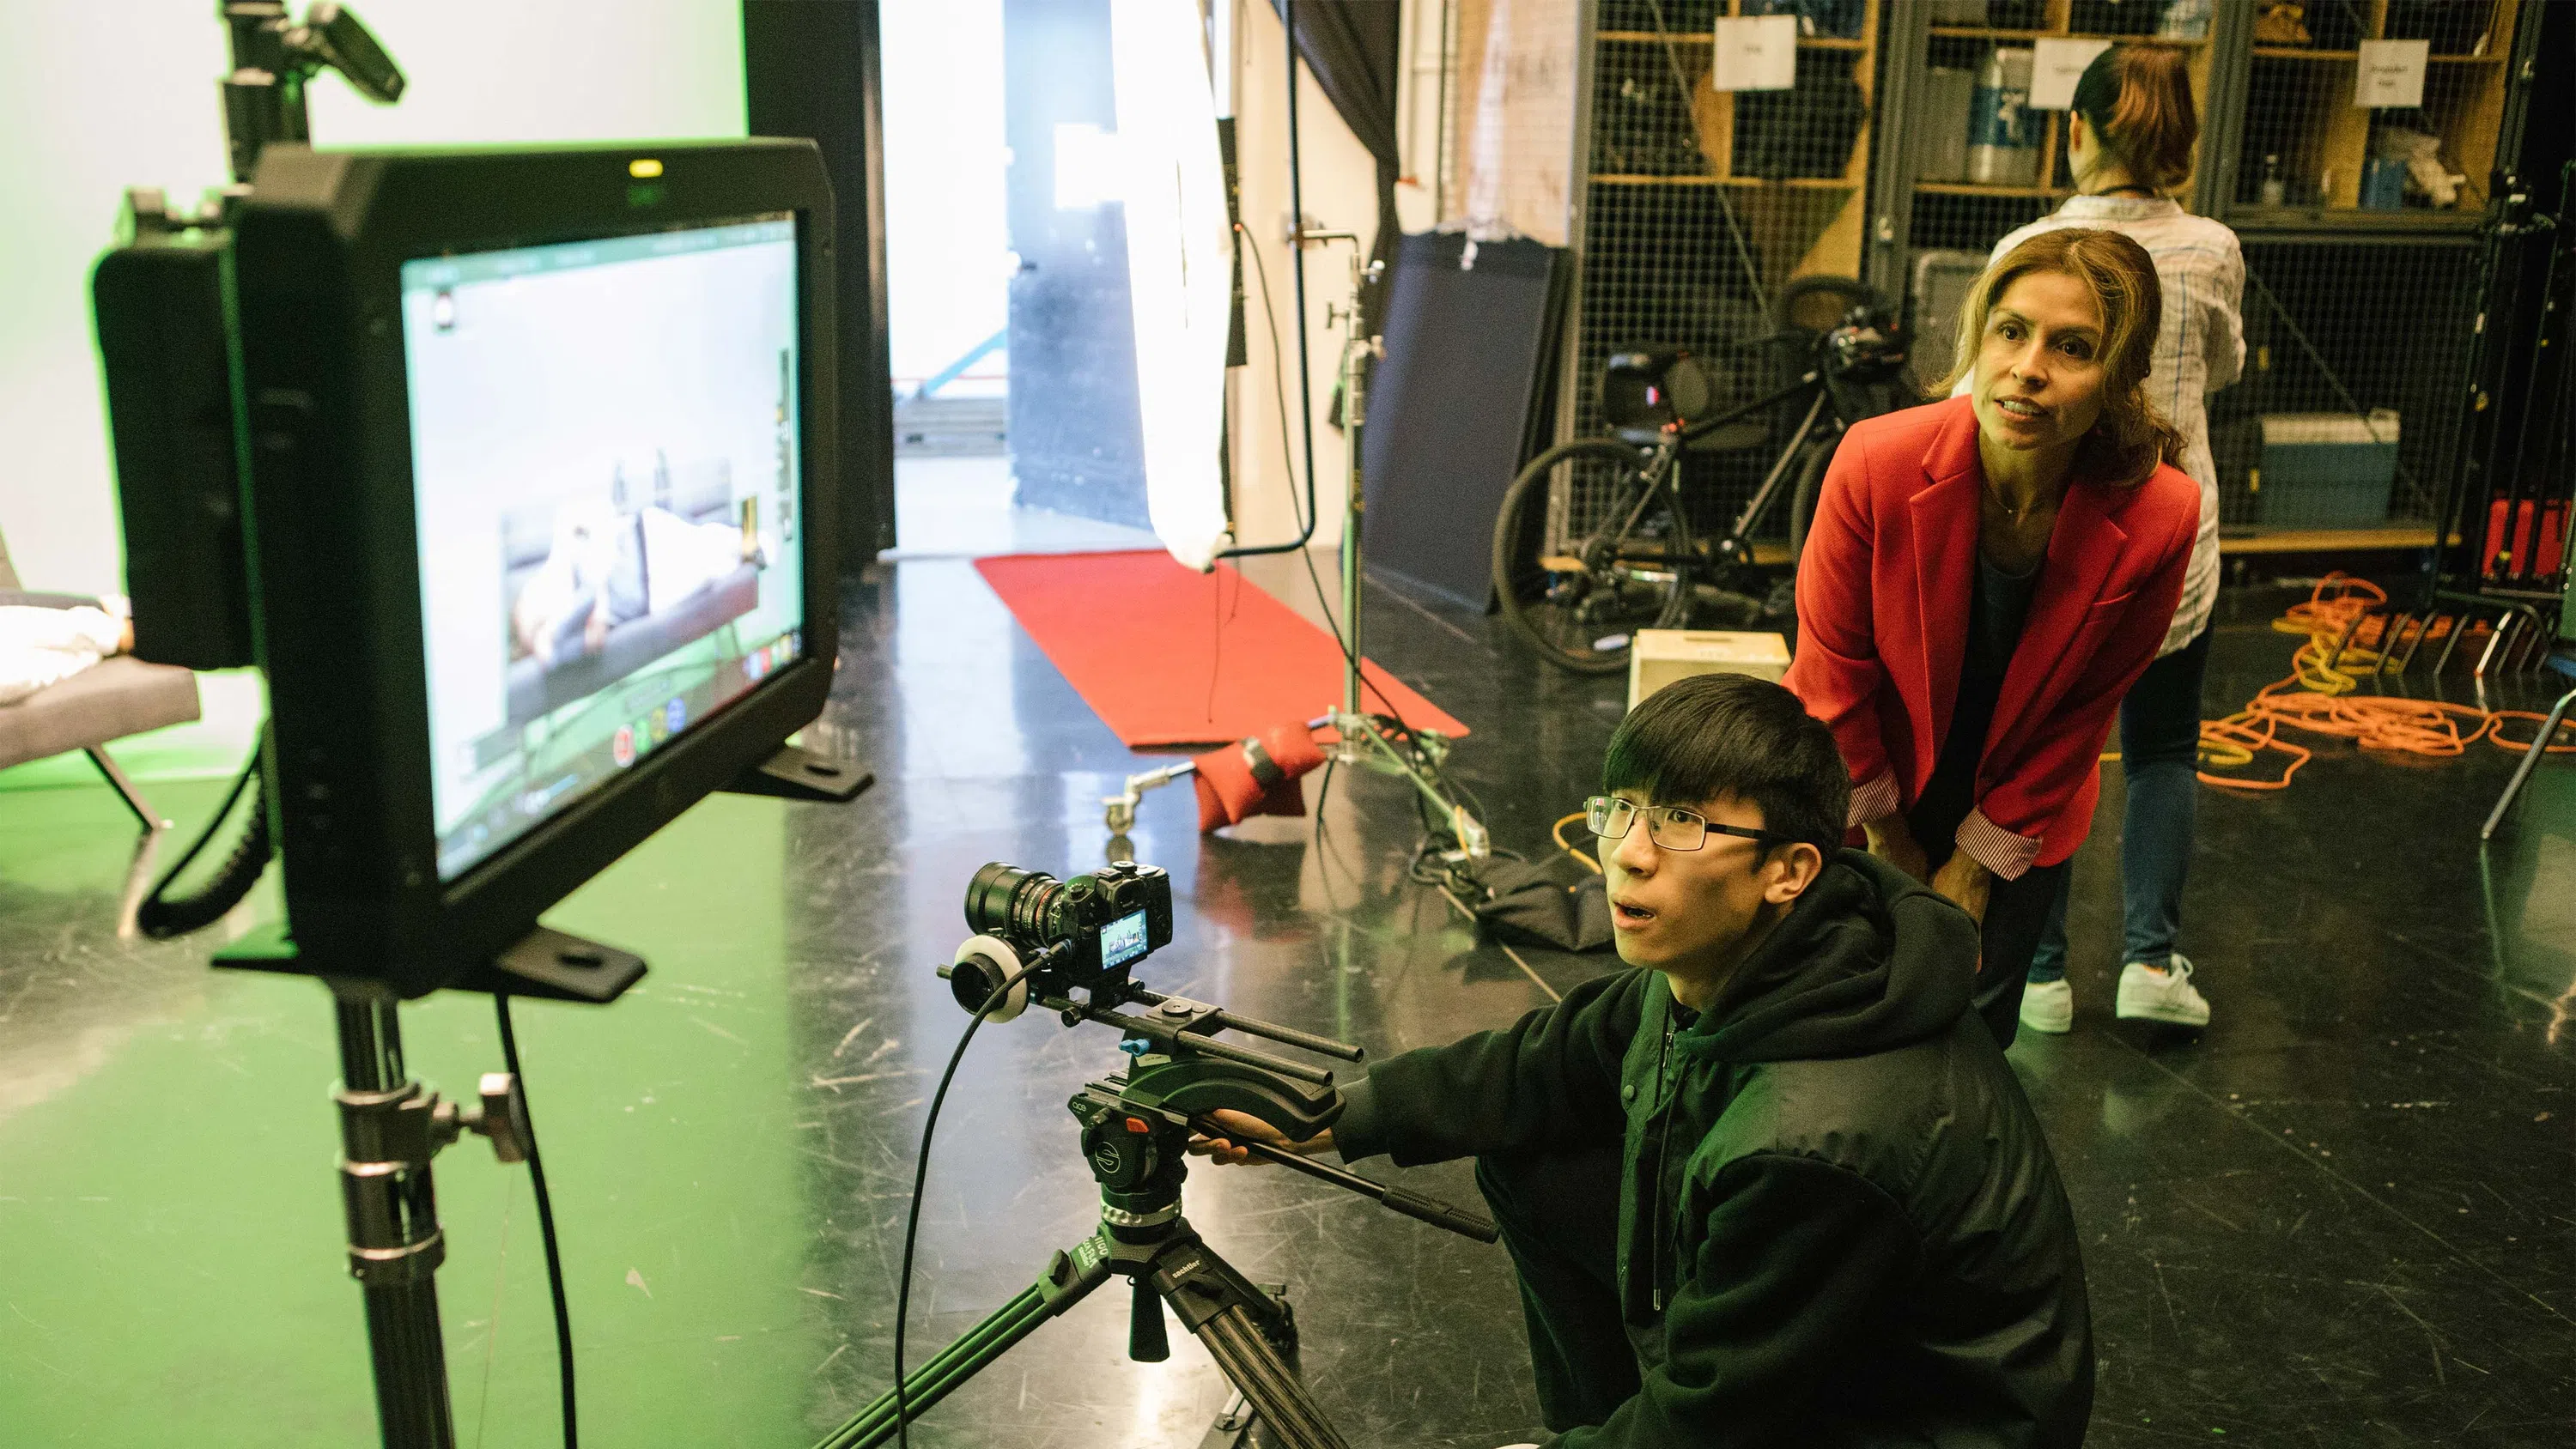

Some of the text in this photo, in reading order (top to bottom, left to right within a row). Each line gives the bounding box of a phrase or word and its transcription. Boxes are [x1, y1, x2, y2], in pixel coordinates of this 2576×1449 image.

[1072, 1101, 1086, 1112] ace
[1094, 1236, 1109, 1256] 1100
[1172, 1259, 1200, 1279] sachtler
